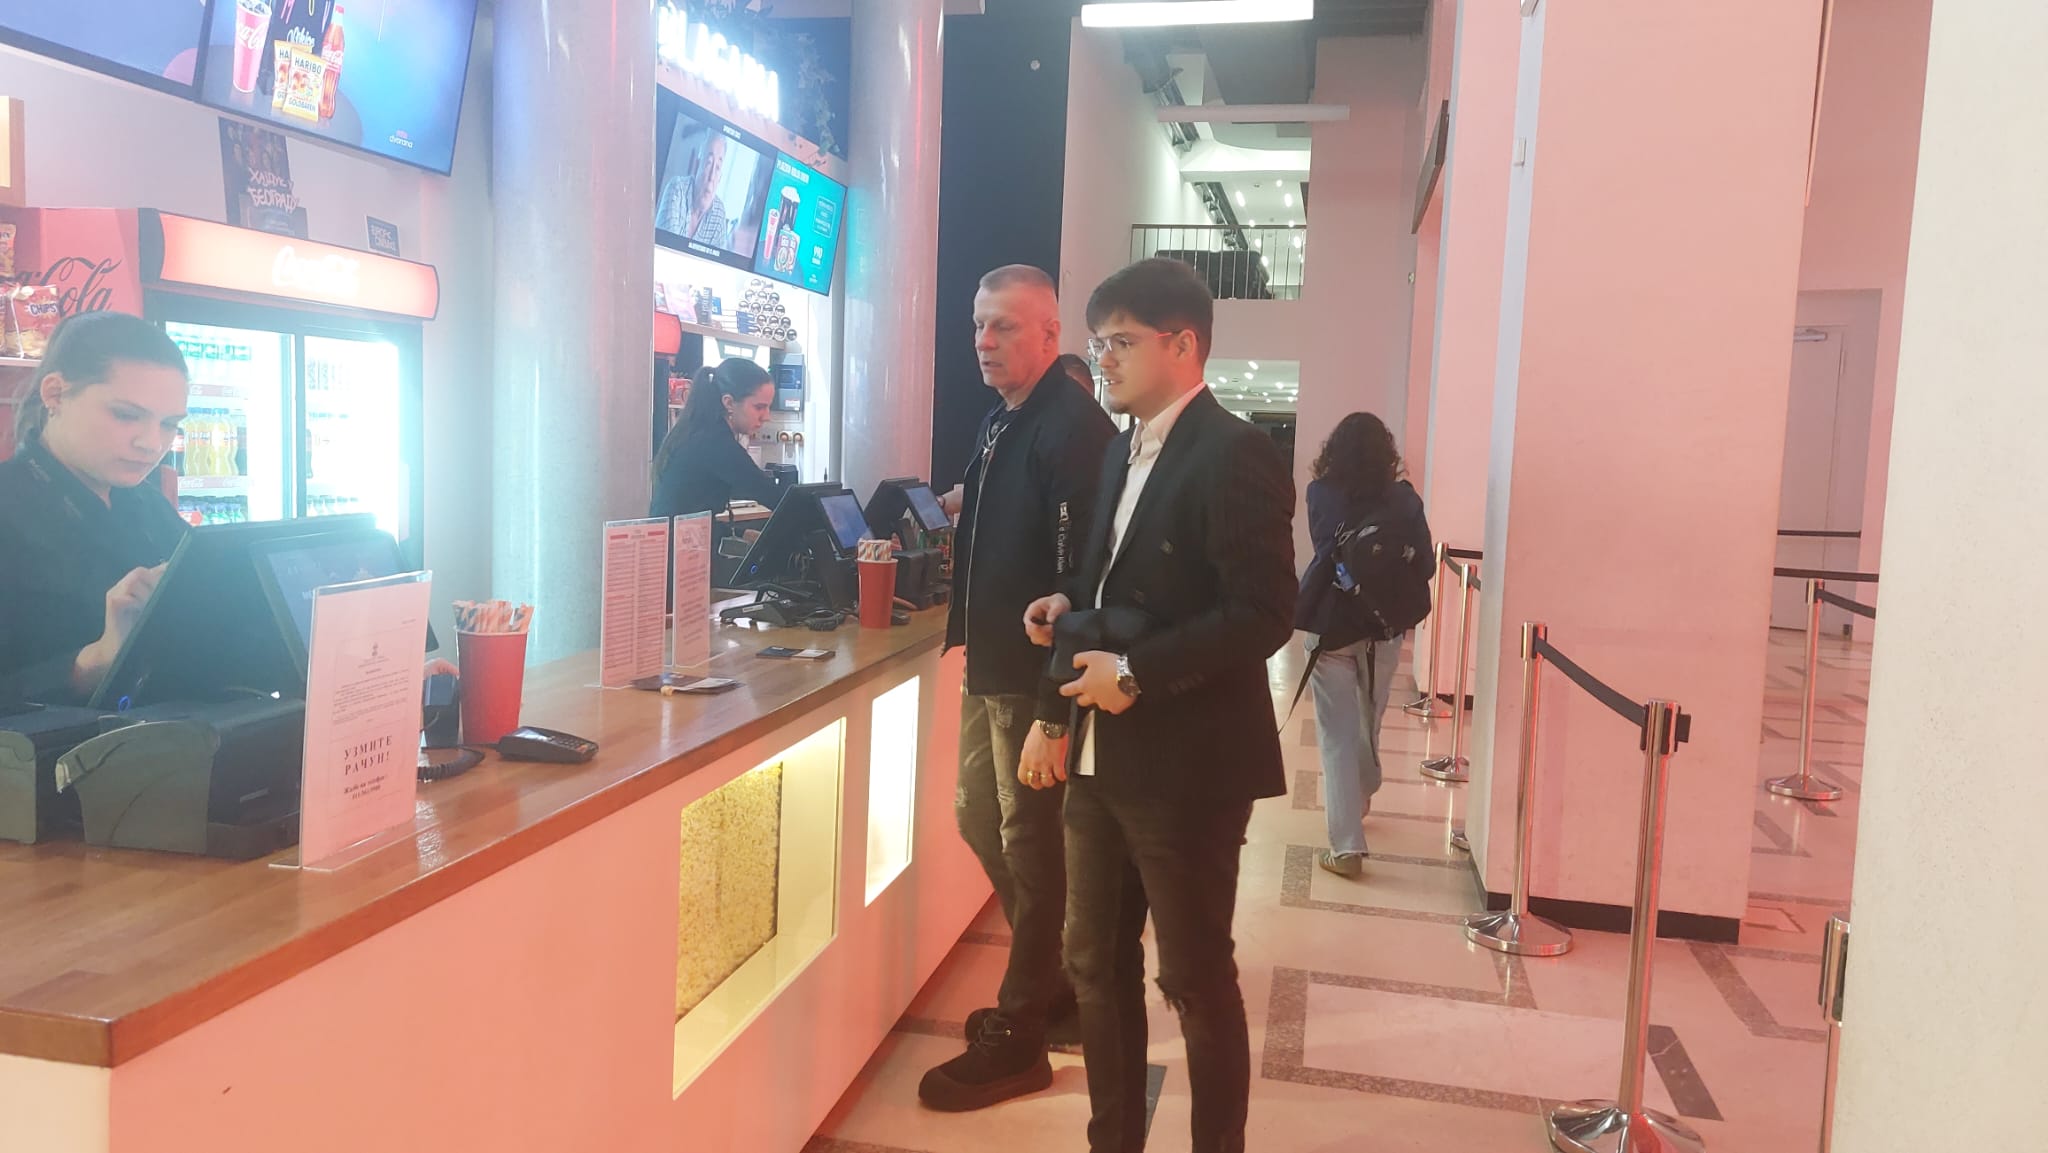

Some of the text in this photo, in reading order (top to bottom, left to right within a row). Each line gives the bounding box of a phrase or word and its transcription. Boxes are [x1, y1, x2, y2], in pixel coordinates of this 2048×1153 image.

[294, 57, 322, 75] HARIBO
[344, 735, 393, 761] УЗМИТЕ
[345, 751, 390, 776] РАЧУН!
